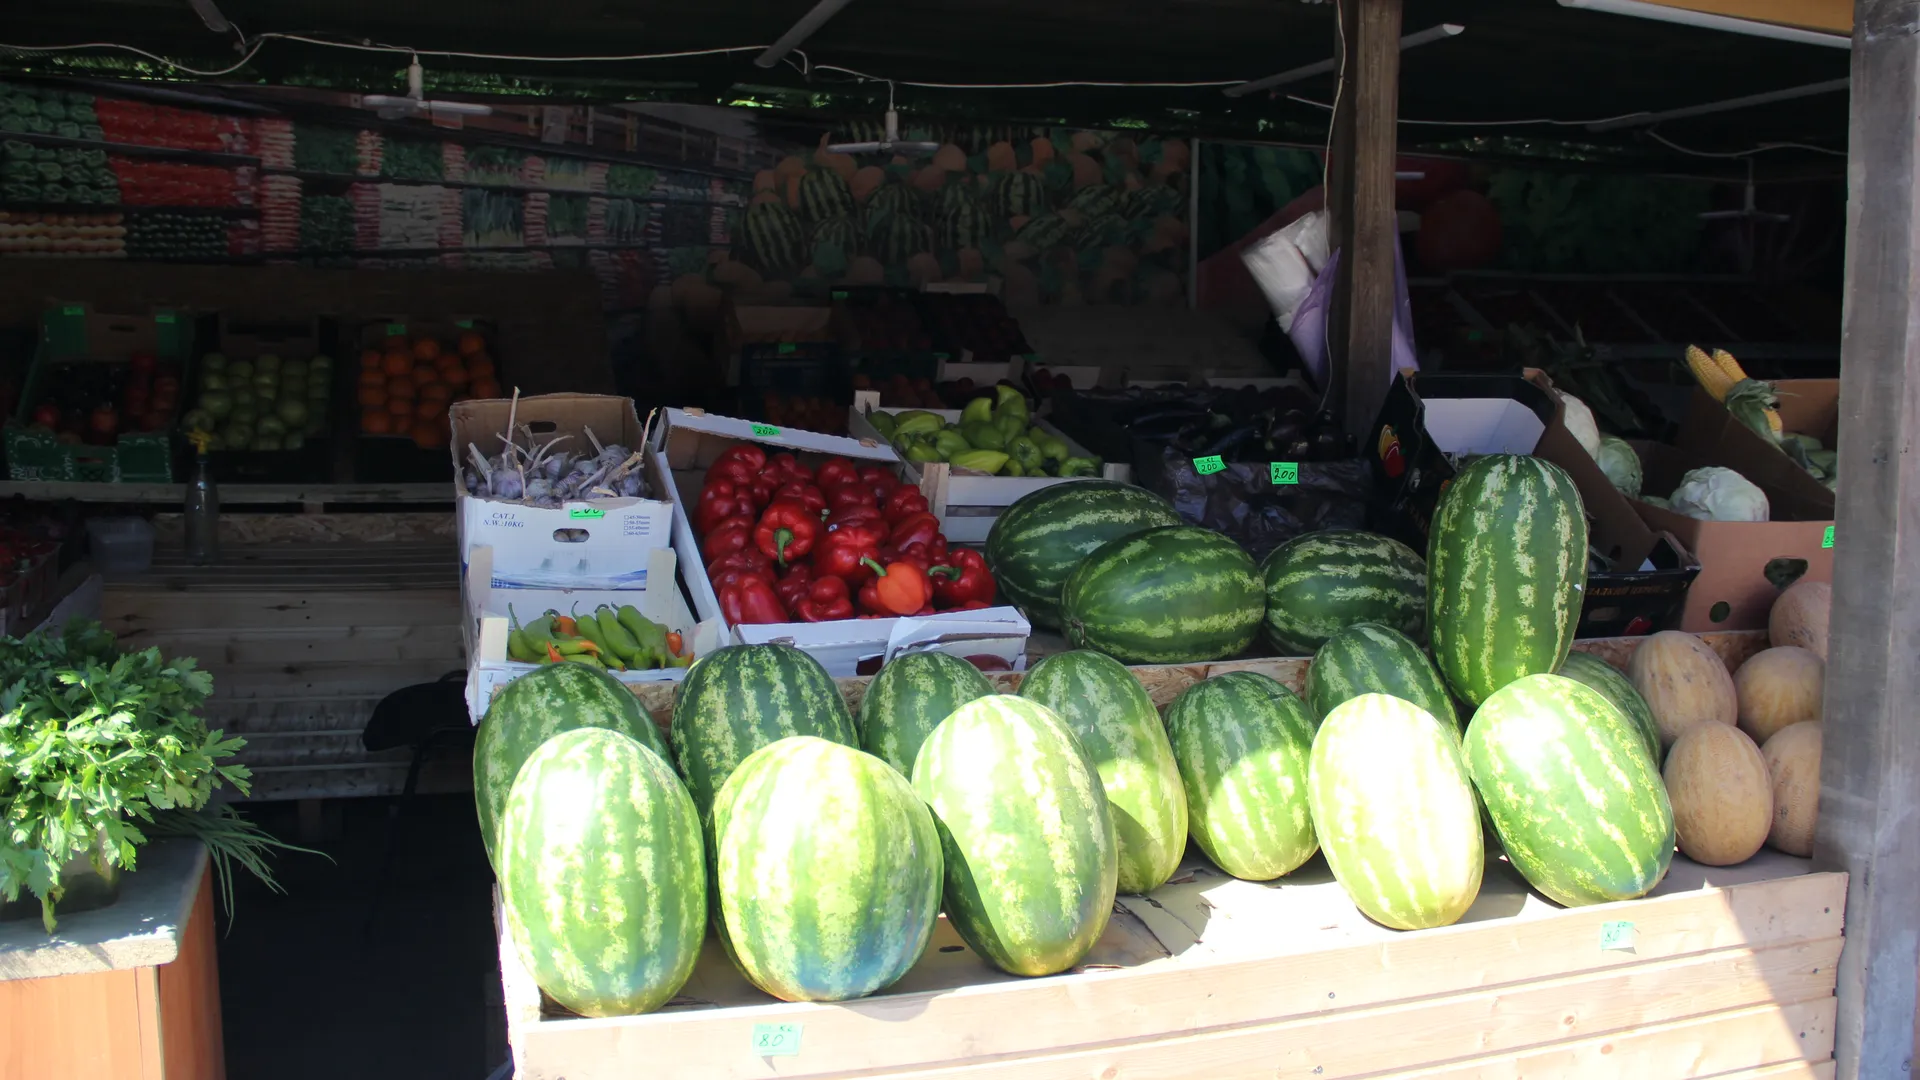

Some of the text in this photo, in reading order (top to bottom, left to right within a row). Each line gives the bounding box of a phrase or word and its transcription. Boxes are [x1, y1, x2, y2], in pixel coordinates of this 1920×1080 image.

[1201, 462, 1218, 473] 200
[1274, 467, 1295, 481] 200
[1604, 929, 1620, 943] 80
[758, 1033, 784, 1047] 80
